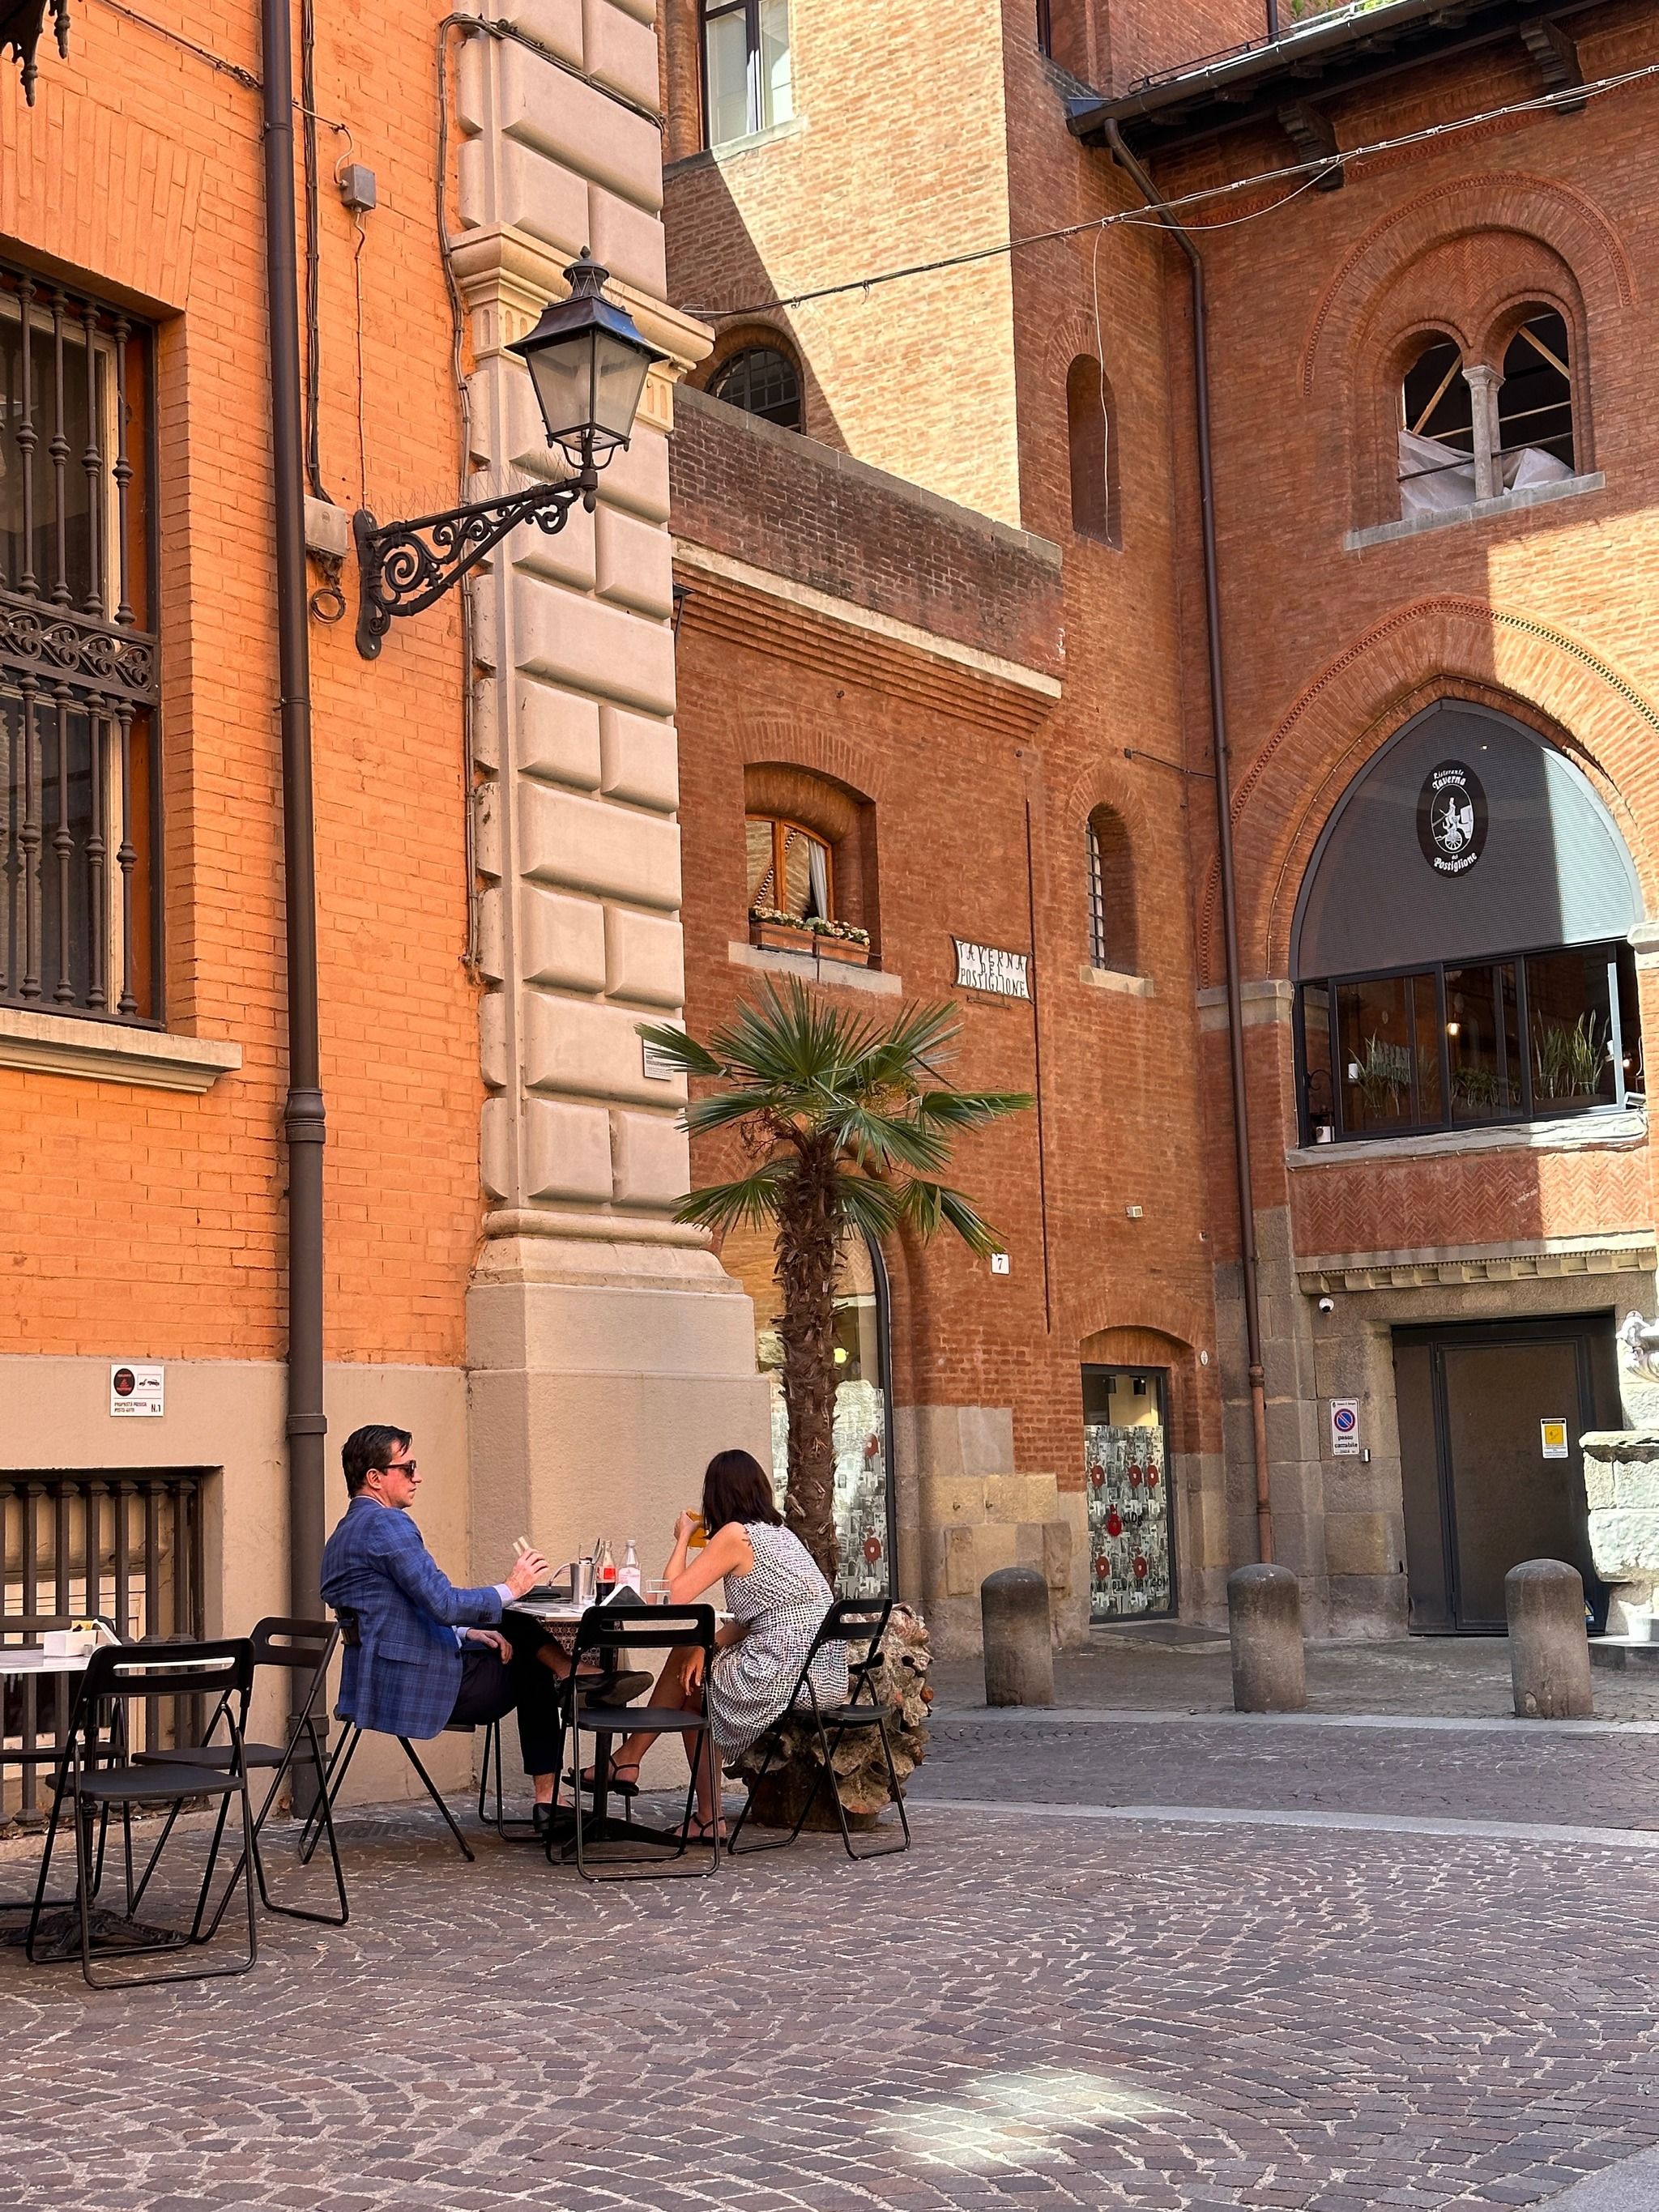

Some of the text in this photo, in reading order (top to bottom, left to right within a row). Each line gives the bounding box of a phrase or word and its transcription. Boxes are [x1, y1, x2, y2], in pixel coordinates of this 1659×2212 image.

[1433, 769, 1465, 779] Ristorante
[1432, 775, 1466, 790] Taverna
[1434, 852, 1478, 872] Postiglione
[958, 943, 1024, 971] TAVERNA
[980, 961, 1003, 977] DEL
[960, 967, 1026, 997] POSTIGLIONE
[997, 1257, 1003, 1270] 7
